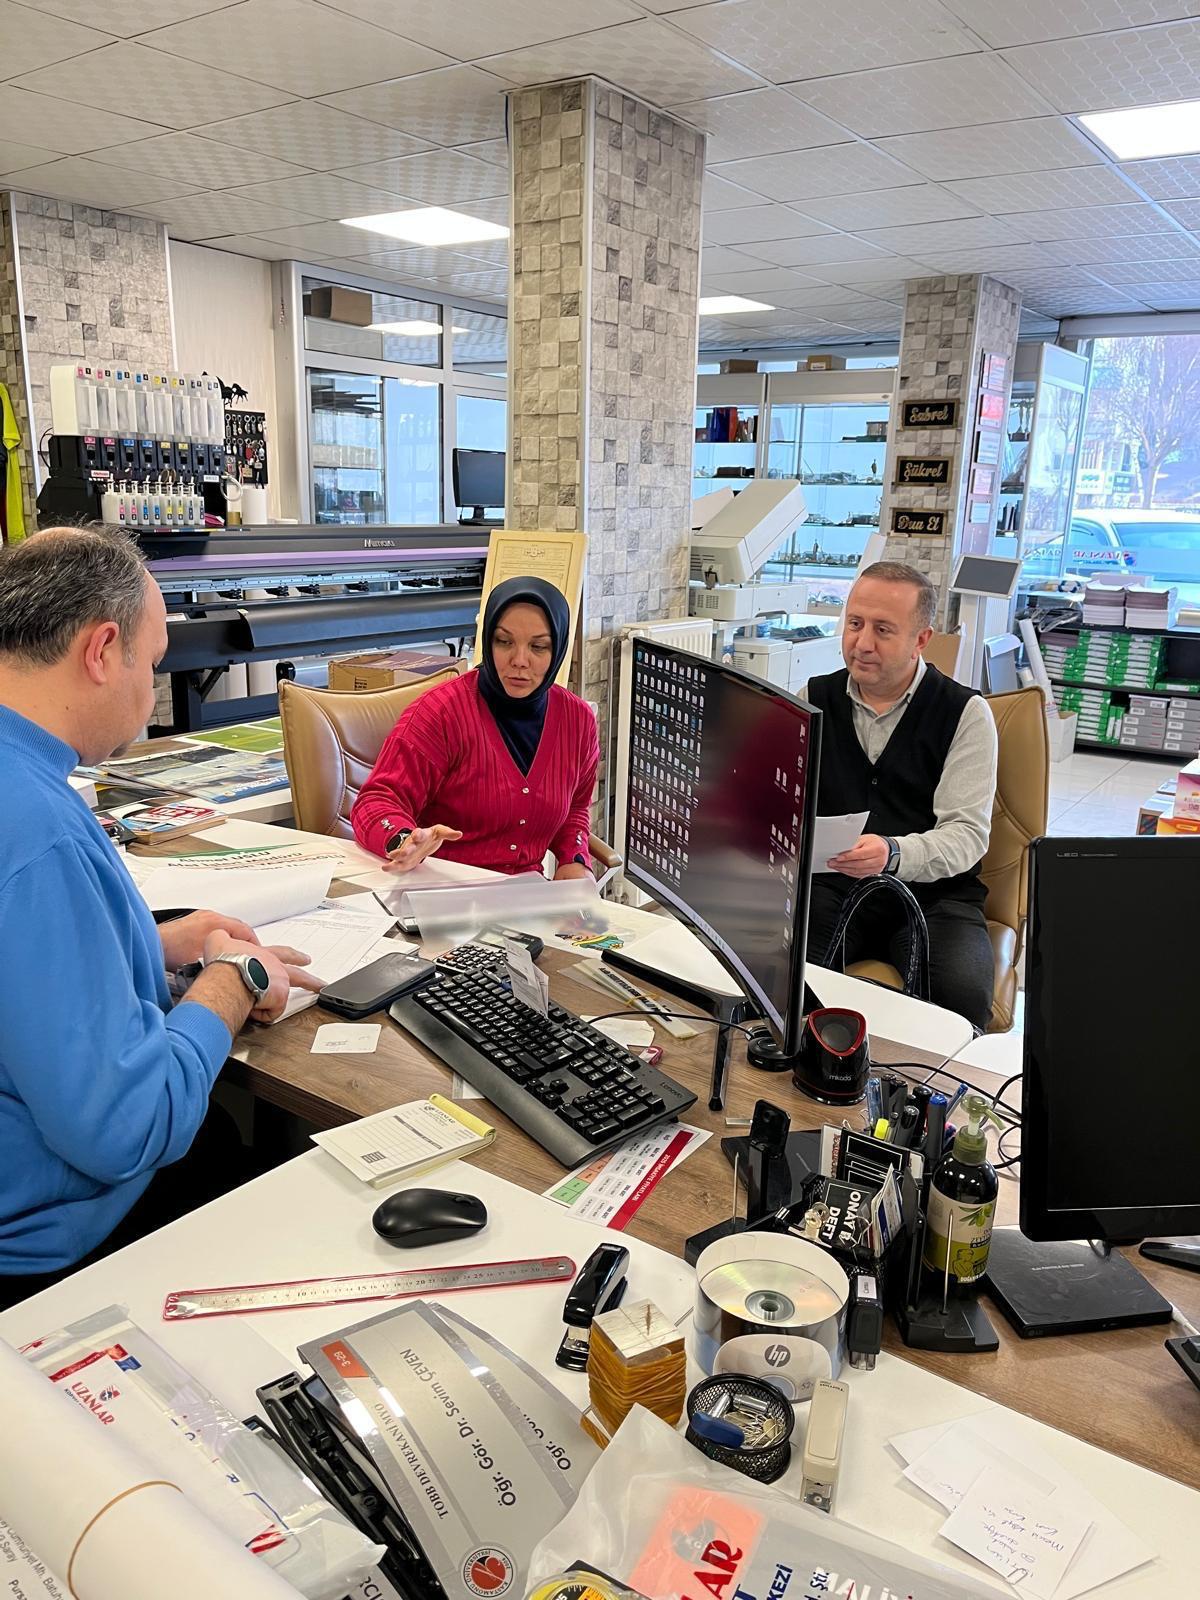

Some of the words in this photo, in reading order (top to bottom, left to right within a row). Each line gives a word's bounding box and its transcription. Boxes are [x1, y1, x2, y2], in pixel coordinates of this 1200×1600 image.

[898, 515, 924, 530] Dua
[843, 1191, 861, 1230] ONAY
[399, 1348, 433, 1383] ÇEVEN
[766, 1345, 788, 1367] hp
[71, 1382, 115, 1425] UZANLAR
[373, 1402, 395, 1432] MYO
[430, 1382, 461, 1417] Sevim
[456, 1416, 475, 1439] Dr.
[390, 1428, 432, 1488] DEVREKANİ
[472, 1438, 495, 1471] Gör.
[427, 1486, 449, 1520] TOBB
[492, 1470, 517, 1507] Öğr.
[7, 1528, 39, 1565] Cumhuriyet
